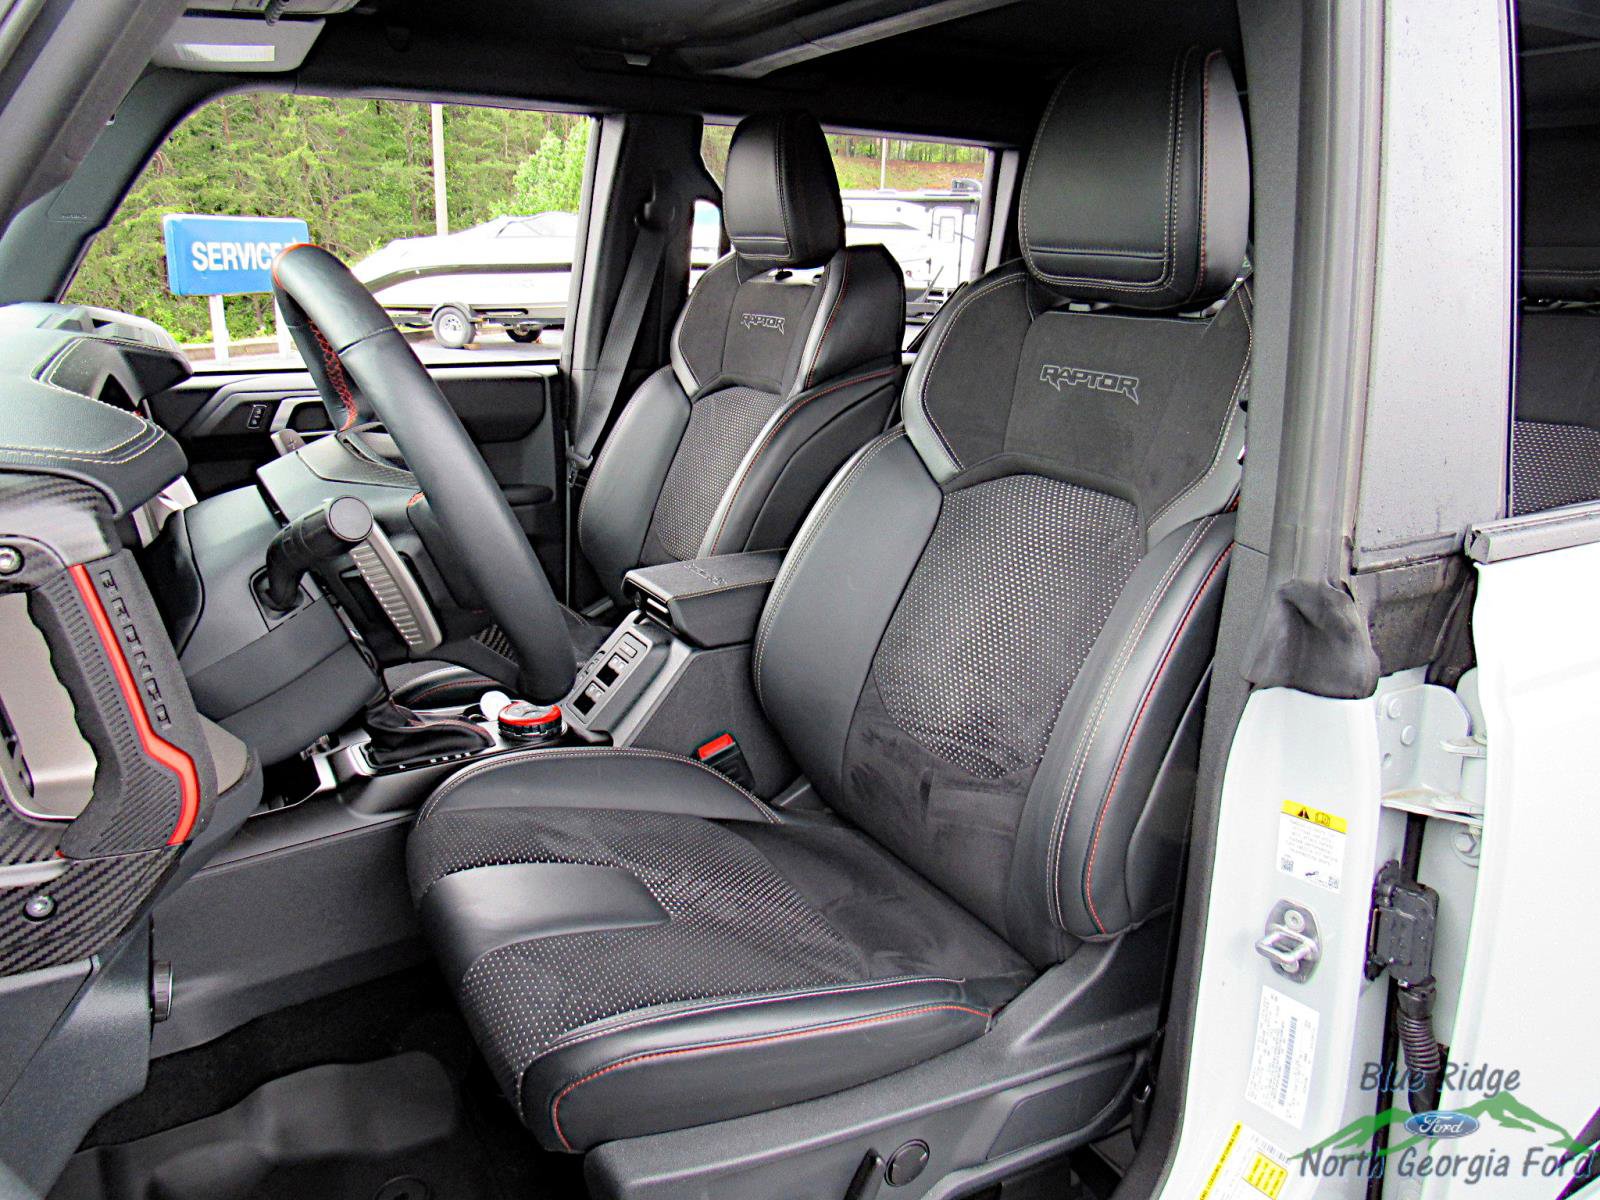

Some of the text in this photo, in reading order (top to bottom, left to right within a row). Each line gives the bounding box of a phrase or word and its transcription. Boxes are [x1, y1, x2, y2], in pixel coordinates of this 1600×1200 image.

[741, 312, 785, 335] RAPTOR
[1039, 363, 1140, 405] RAPTOR
[99, 569, 172, 730] BRONCO
